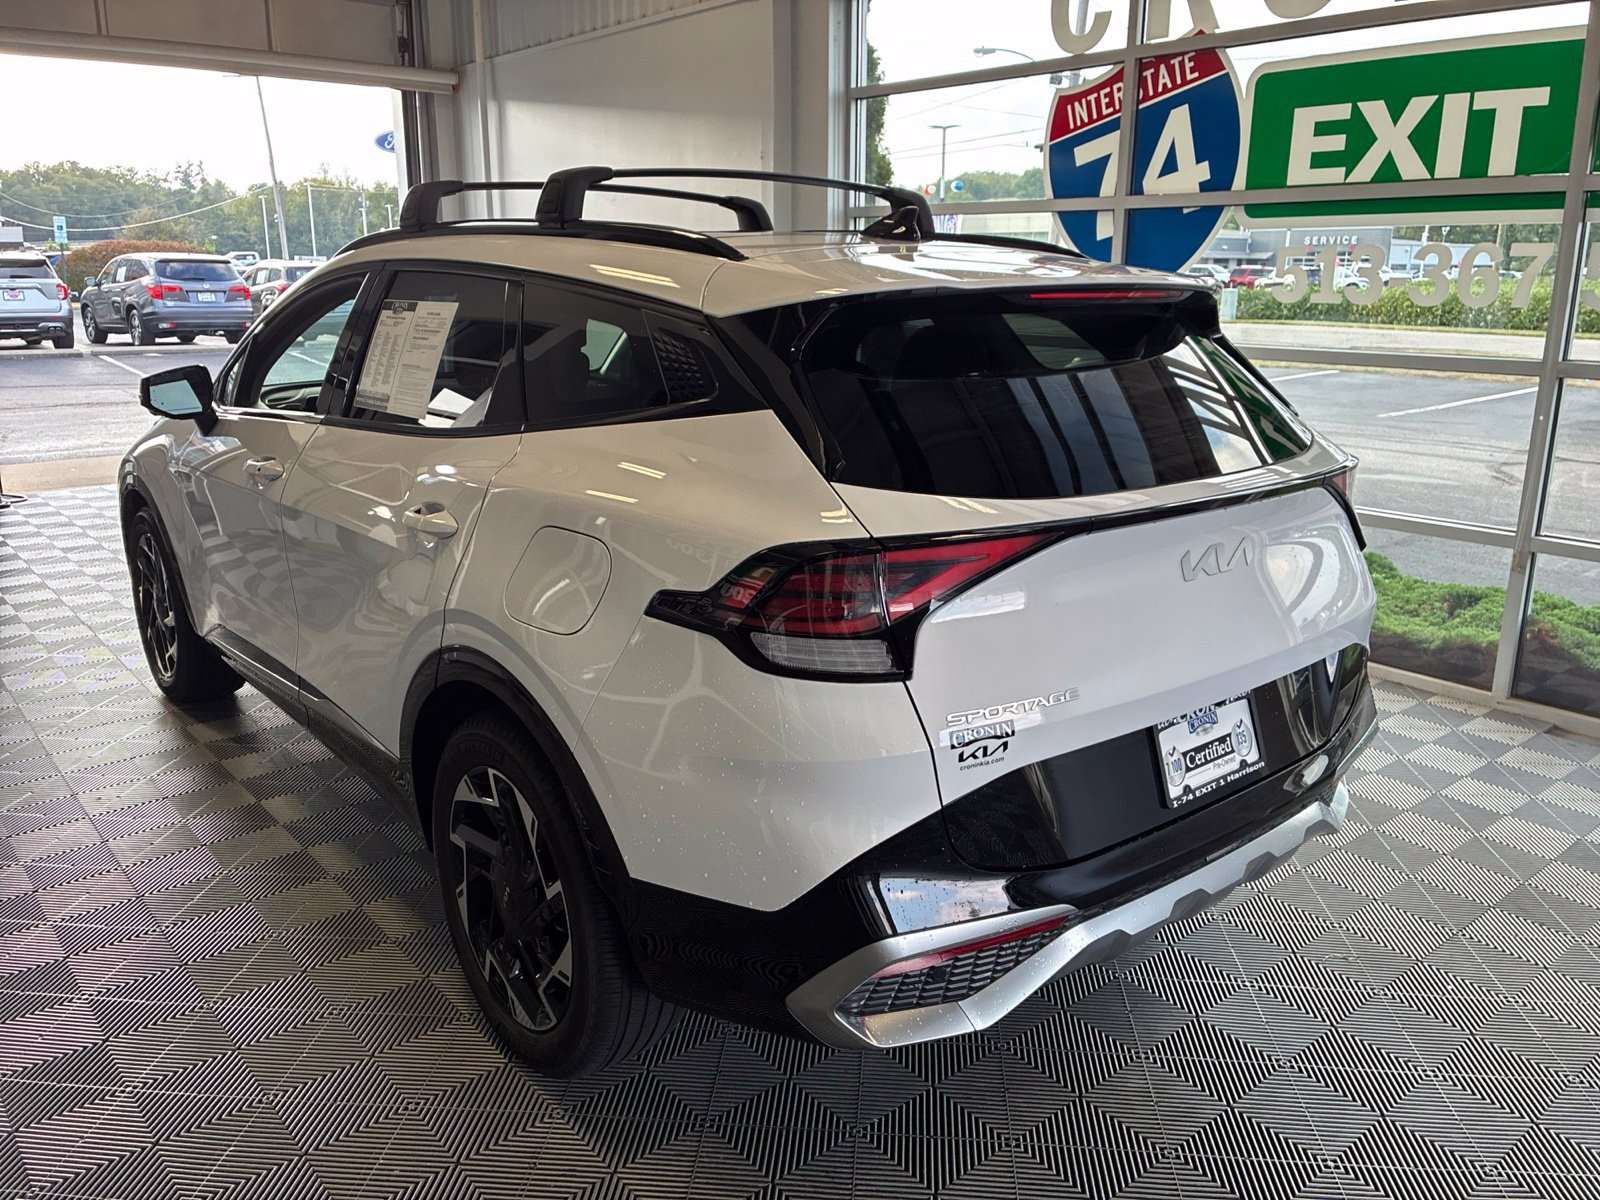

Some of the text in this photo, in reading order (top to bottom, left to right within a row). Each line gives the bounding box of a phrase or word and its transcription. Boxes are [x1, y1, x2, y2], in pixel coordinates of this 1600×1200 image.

[1067, 52, 1199, 129] INTERTATE
[1287, 86, 1551, 186] EXIT
[1074, 103, 1211, 241] 74
[1303, 235, 1359, 247] SERVICE
[946, 686, 1080, 726] SPORTAGE
[952, 721, 1013, 748] CRONIN
[1188, 711, 1219, 733] CRONIN
[958, 741, 1009, 763] KIA
[959, 756, 1005, 771] croninkia.com
[1186, 737, 1232, 768] Certified
[1173, 761, 1265, 808] I-74 EXIT 1 Harrison
